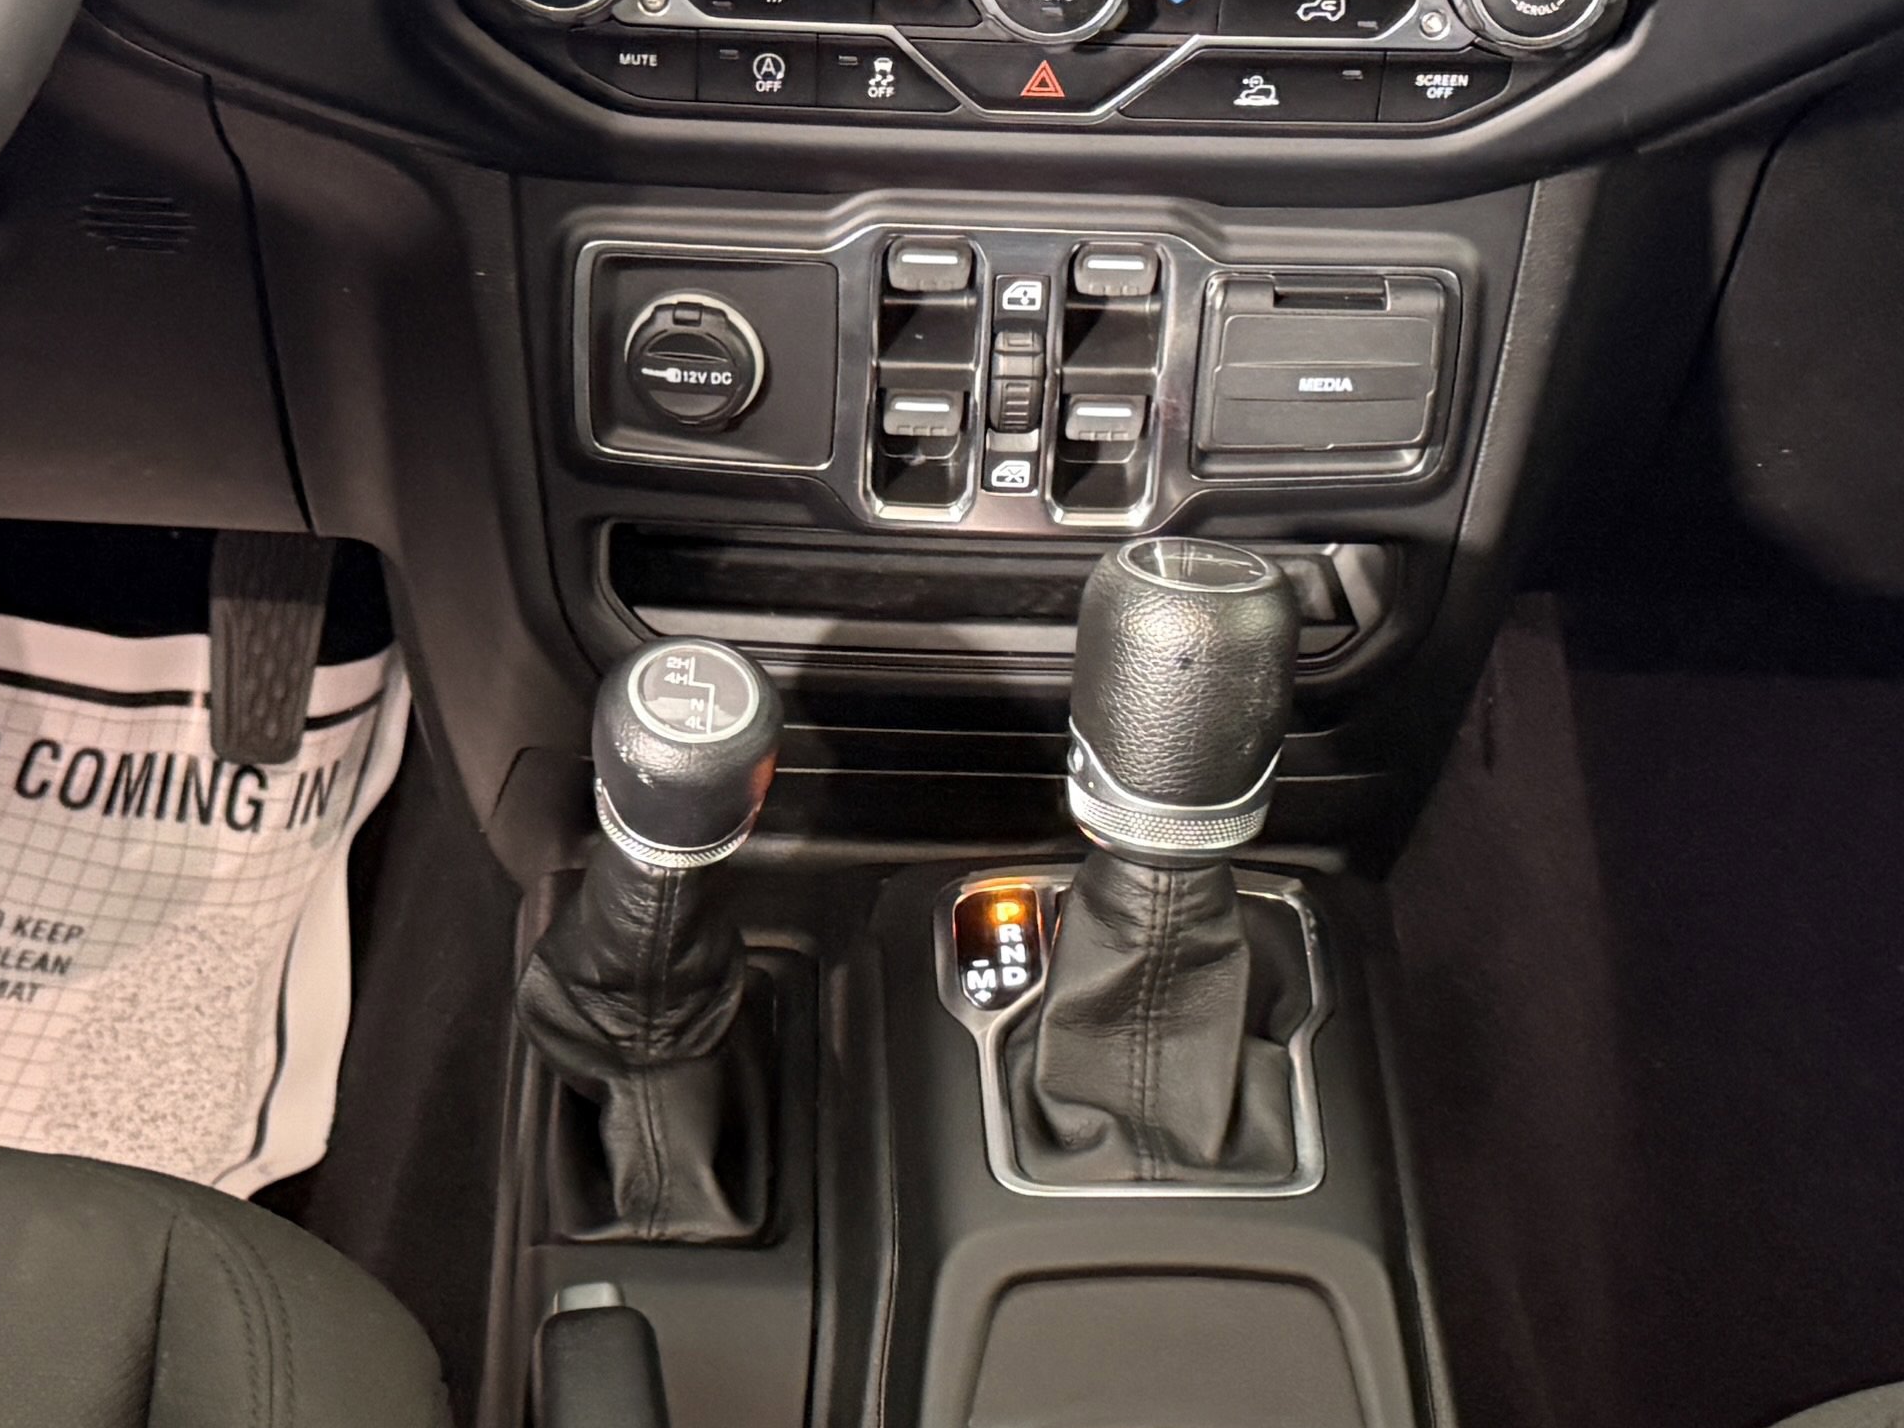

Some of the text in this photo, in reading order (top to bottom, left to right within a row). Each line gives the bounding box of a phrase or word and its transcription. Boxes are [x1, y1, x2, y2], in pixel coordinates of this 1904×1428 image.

[1515, 0, 1563, 16] SCROLL
[618, 52, 658, 68] MUTE
[754, 79, 783, 93] OFF
[1415, 73, 1469, 88] SCREEN
[867, 85, 895, 99] OFF
[1426, 86, 1453, 100] OFF
[683, 371, 733, 385] 12V DC
[1299, 376, 1354, 394] MEDIA
[666, 656, 690, 670] 2H
[664, 671, 689, 686] 4H
[690, 698, 705, 712] N
[685, 715, 705, 730] 4L
[14, 738, 269, 834] COMING
[286, 760, 340, 831] IN
[995, 901, 1020, 922] P
[12, 914, 84, 944] KEEP
[999, 923, 1023, 943] R
[1000, 943, 1026, 964] N
[966, 968, 996, 990] M
[1002, 966, 1027, 987] D
